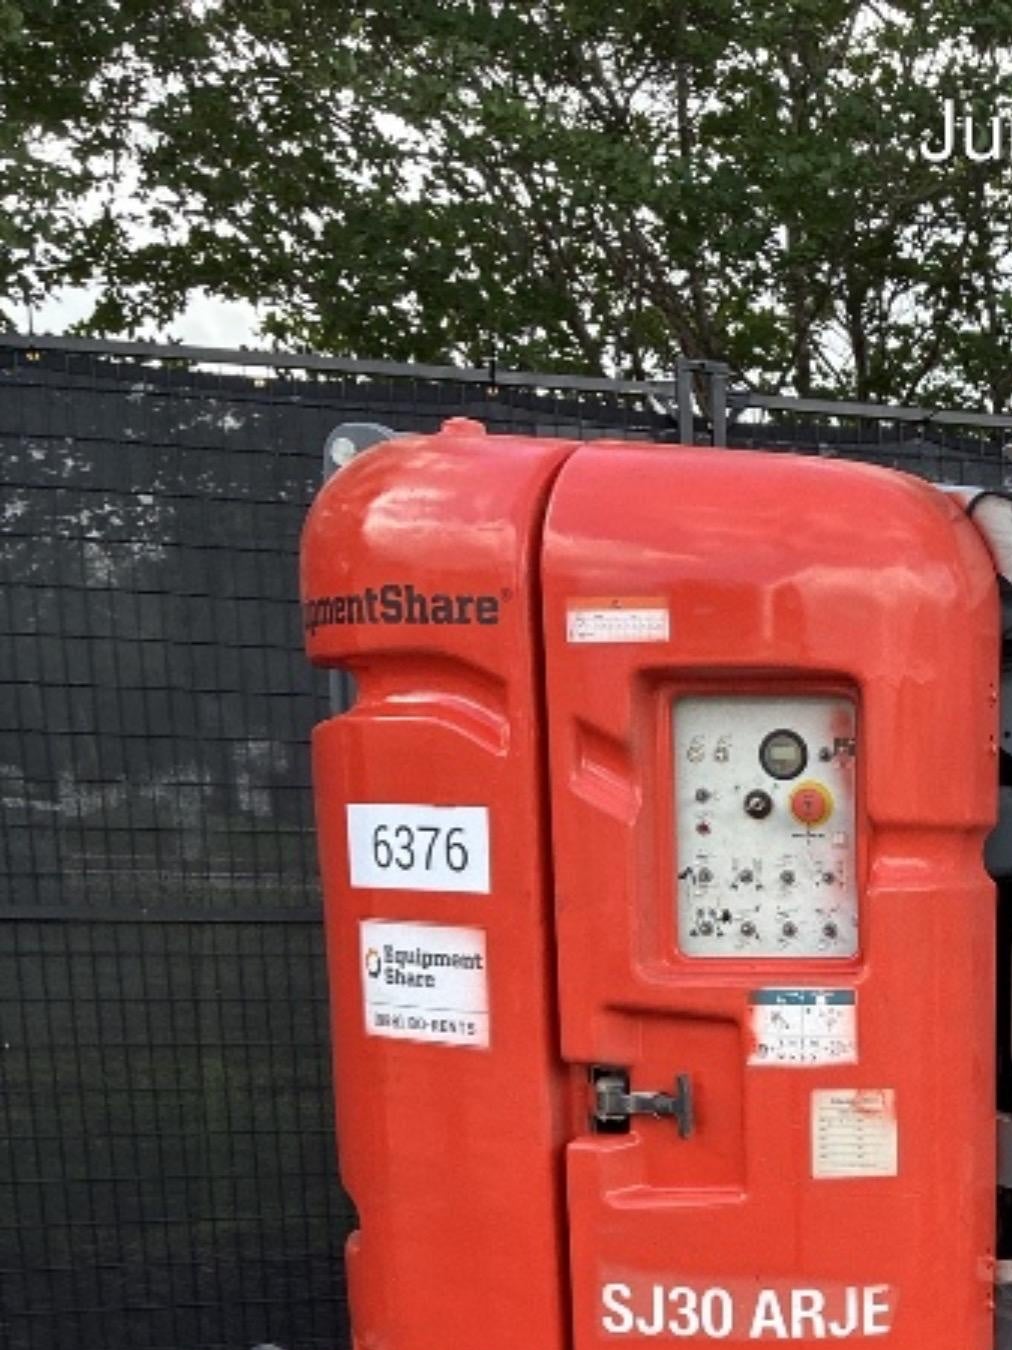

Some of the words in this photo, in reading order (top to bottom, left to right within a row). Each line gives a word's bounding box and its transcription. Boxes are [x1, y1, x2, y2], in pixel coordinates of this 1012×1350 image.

[373, 824, 469, 873] 6376
[383, 944, 483, 970] Equipment
[384, 965, 435, 988] Share
[602, 1283, 733, 1338] SJ30
[749, 1284, 892, 1339] ARJE
